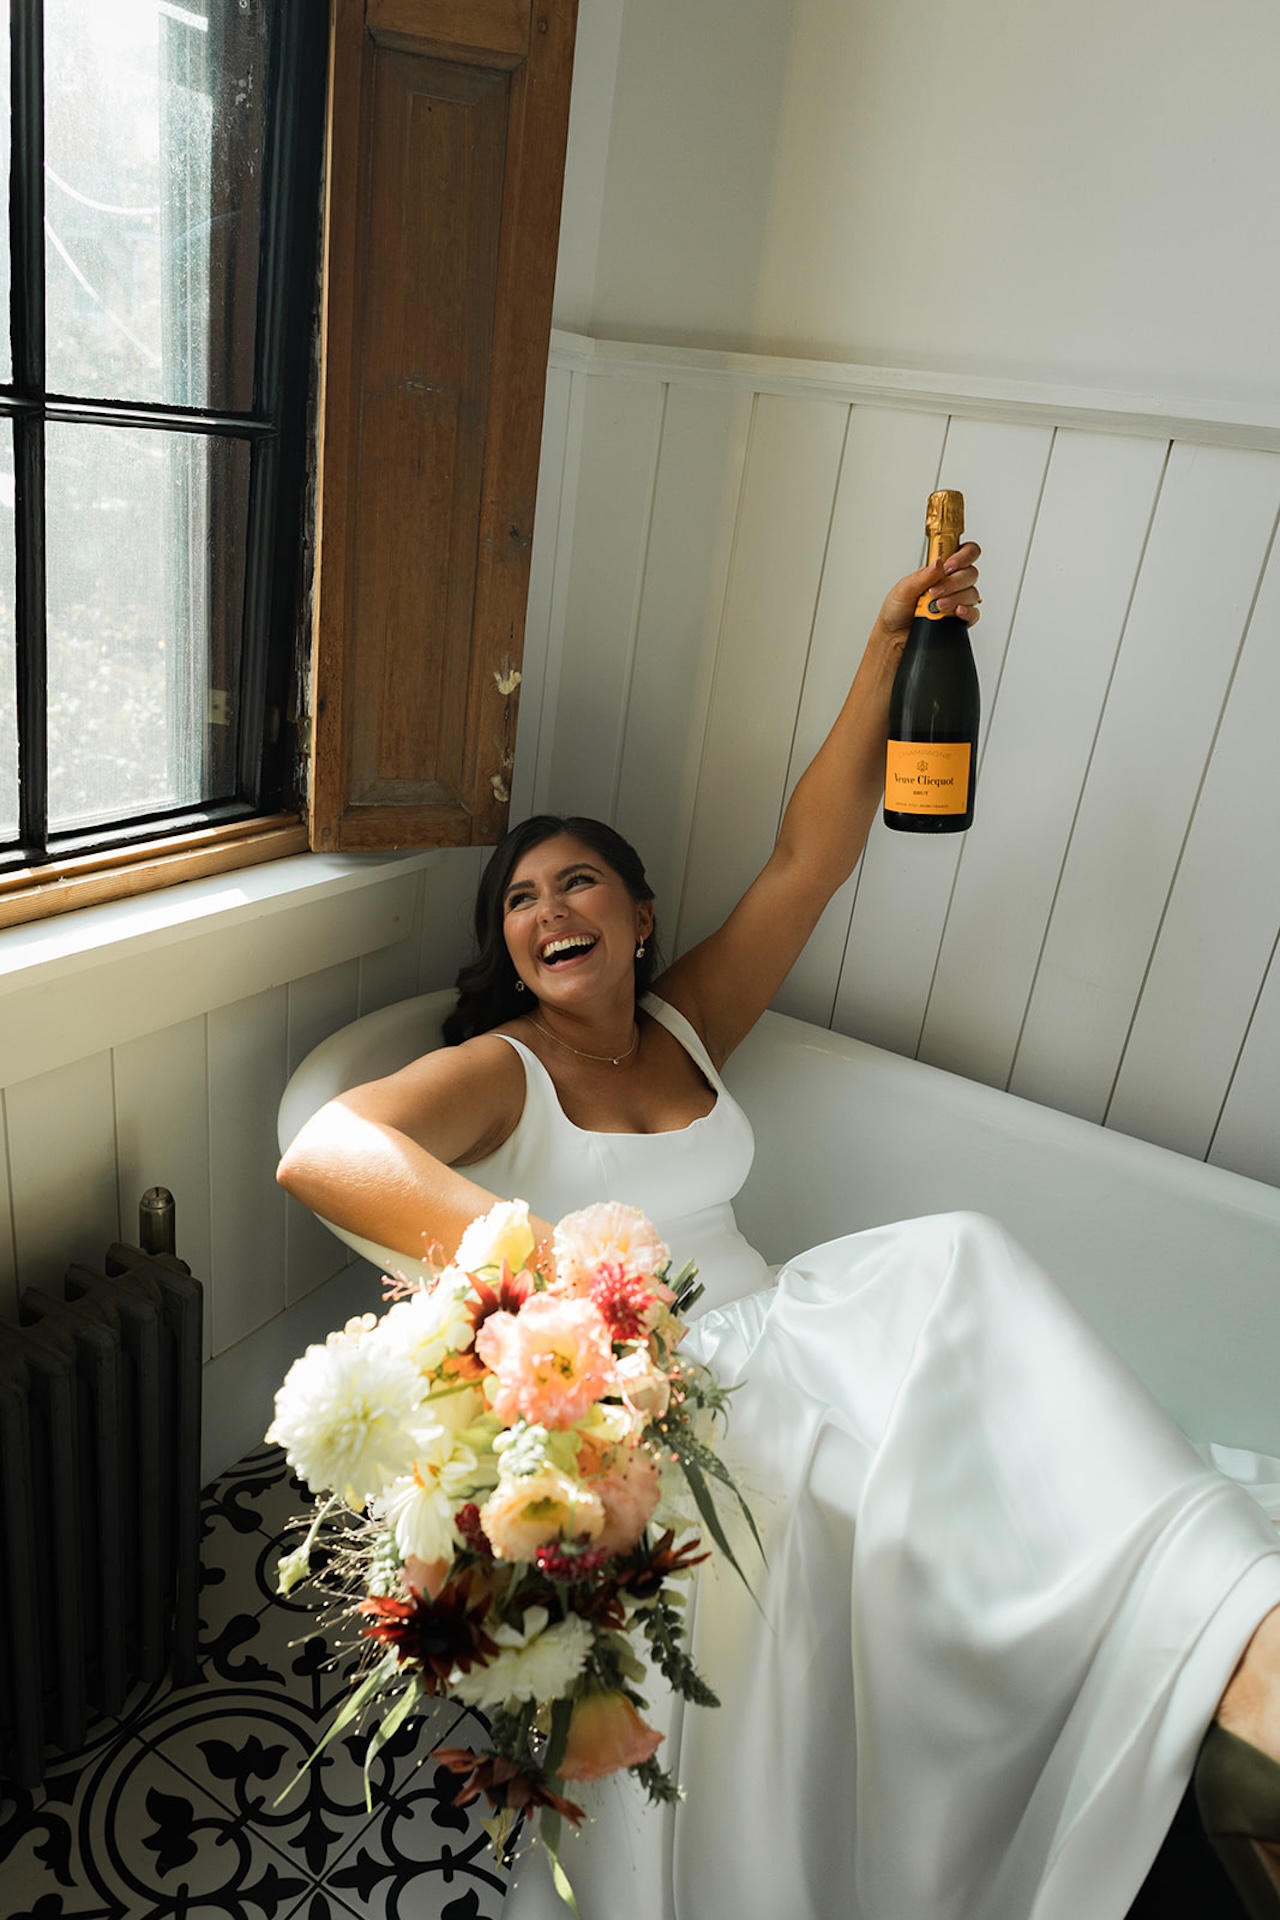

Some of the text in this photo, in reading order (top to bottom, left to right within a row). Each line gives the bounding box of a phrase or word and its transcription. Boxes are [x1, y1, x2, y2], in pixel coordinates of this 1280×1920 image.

[897, 749, 951, 761] CHAMPAGNE
[894, 773, 954, 788] Veuve Clicquot
